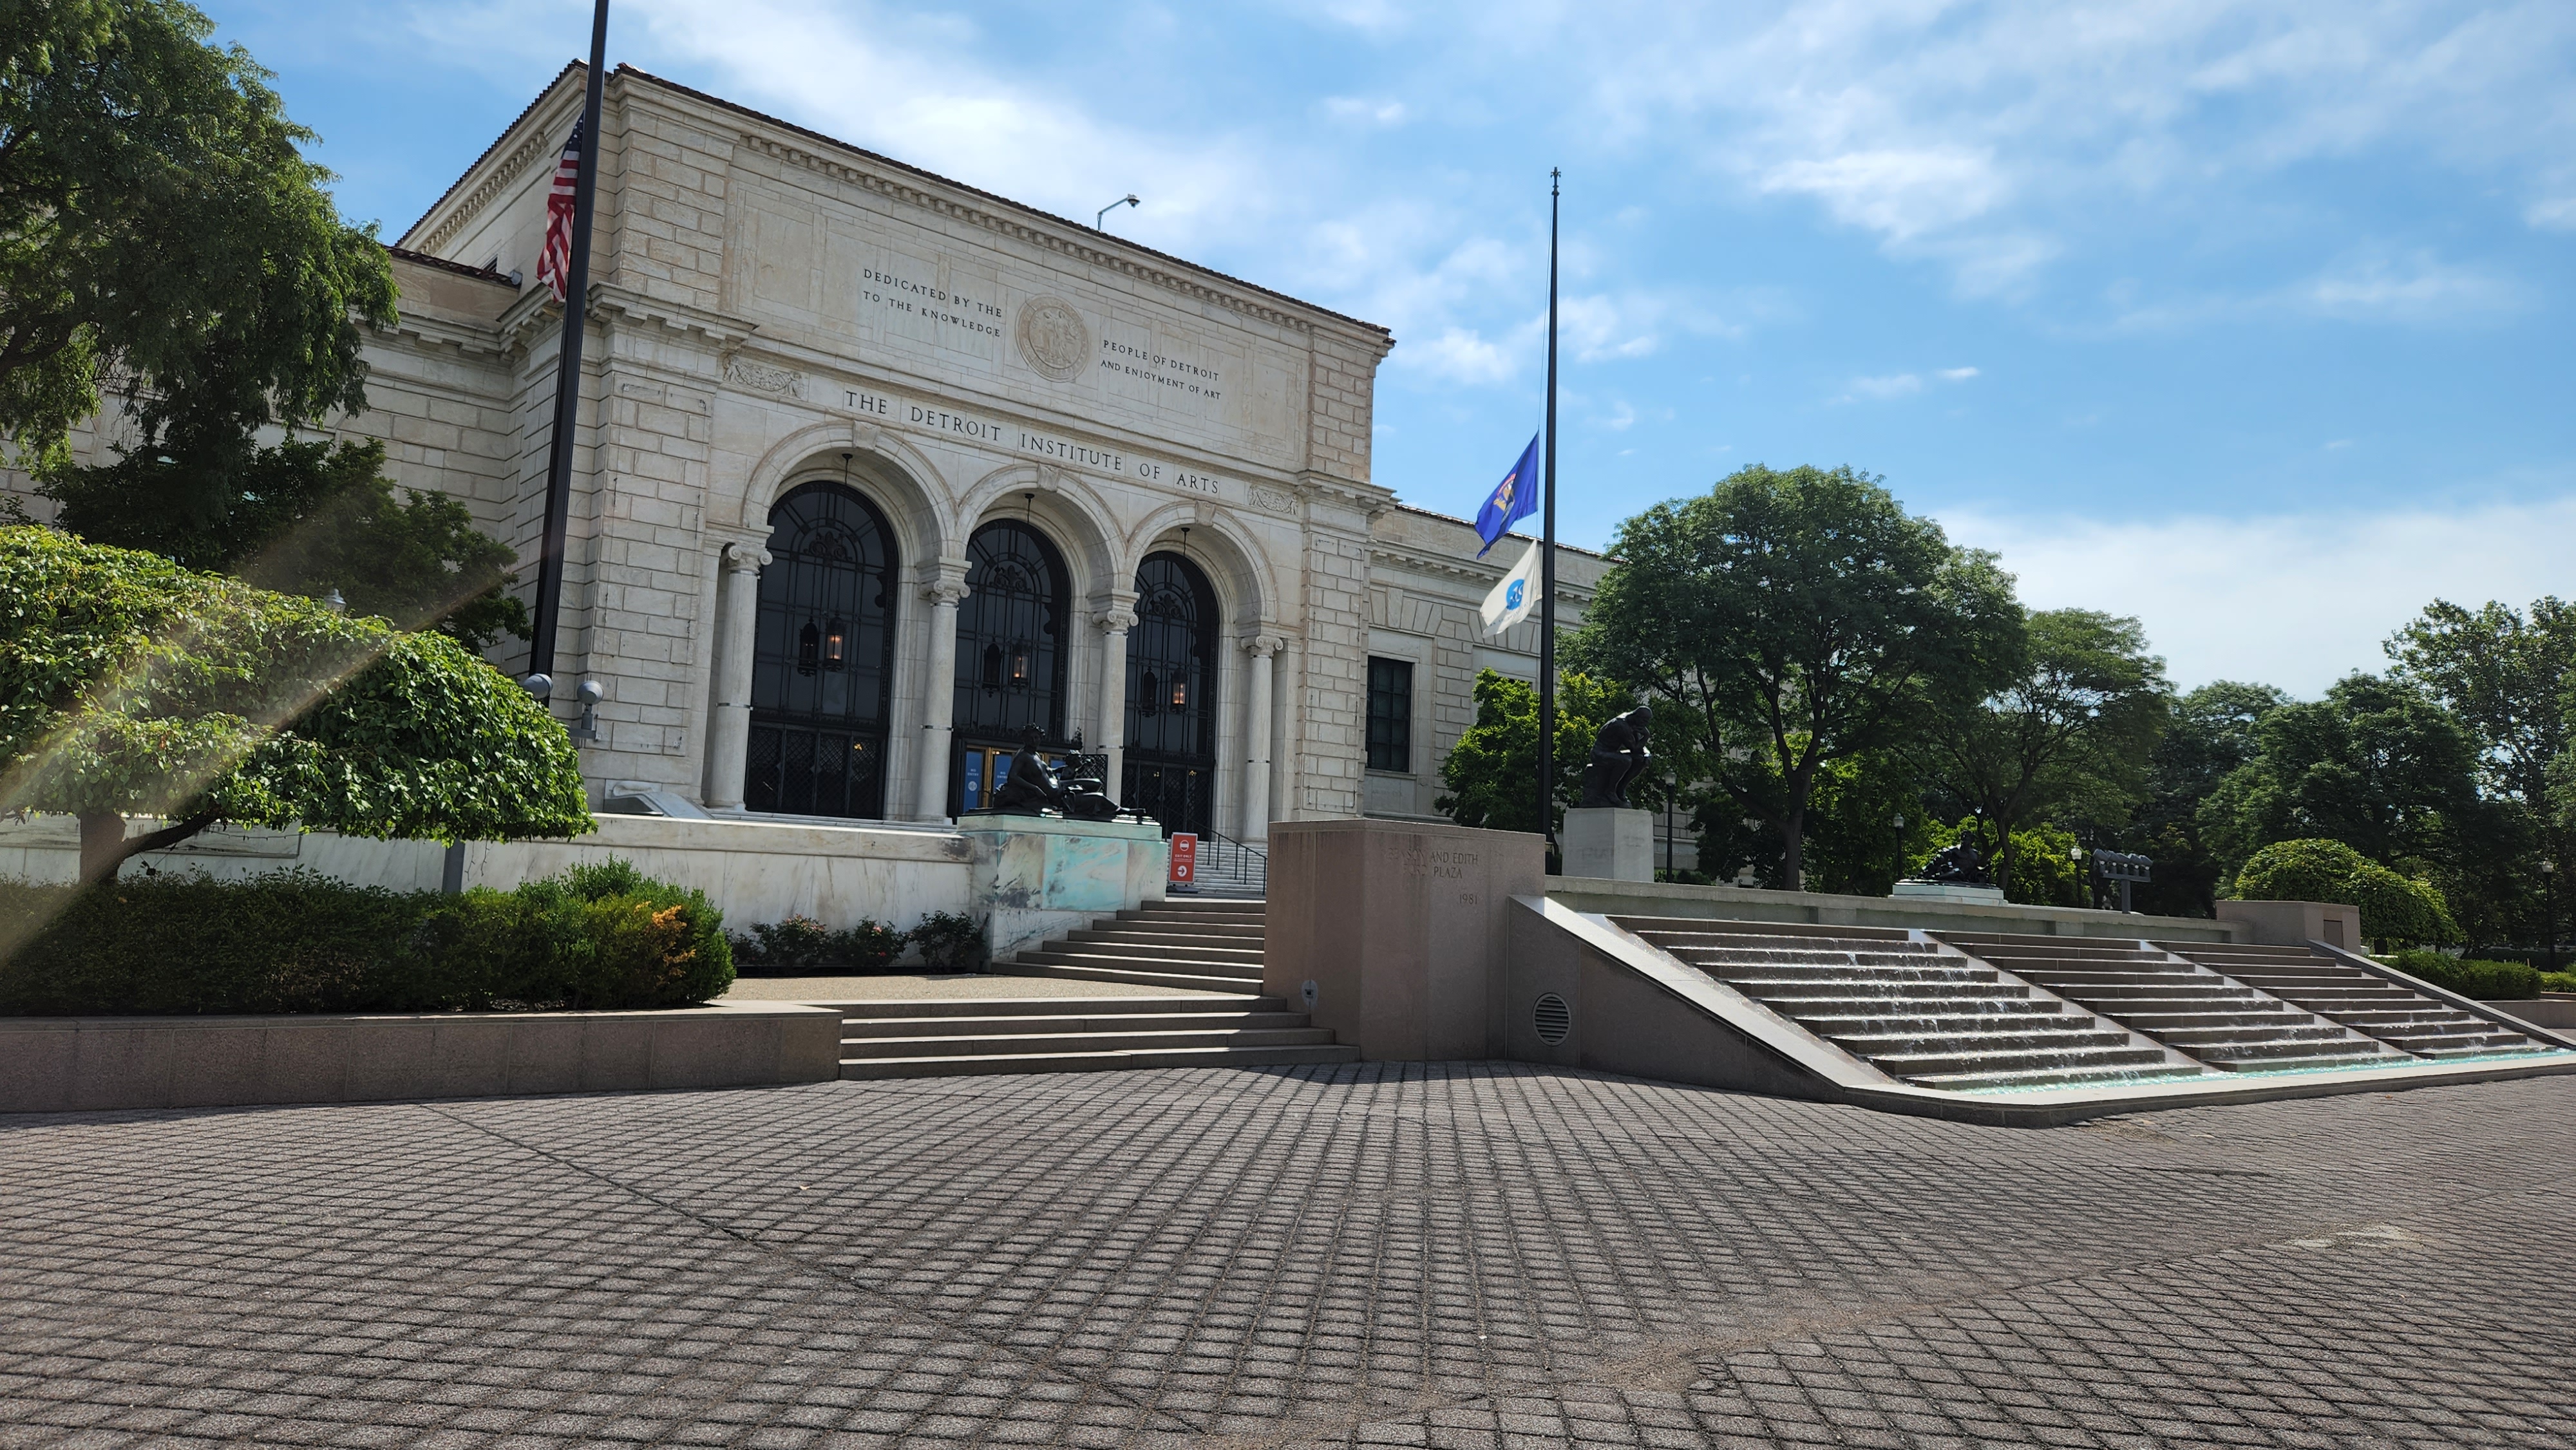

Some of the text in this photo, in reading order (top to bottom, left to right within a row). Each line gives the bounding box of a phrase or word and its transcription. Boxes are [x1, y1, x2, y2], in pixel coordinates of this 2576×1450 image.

[864, 268, 1002, 317] DEDICATED BY THE
[863, 290, 1000, 337] TO THE KNOWLEDGE
[1101, 359, 1221, 400] AND ENJOYMENT OF ART
[1103, 339, 1219, 381] PEOPLE OF DETROIT
[846, 390, 1218, 494] THE DETROIT INSTITUTE OF ARTS
[1431, 851, 1449, 863] AND
[1453, 852, 1478, 865] EDITH
[1434, 866, 1463, 879] PLAZA
[1459, 893, 1478, 905] 1981
